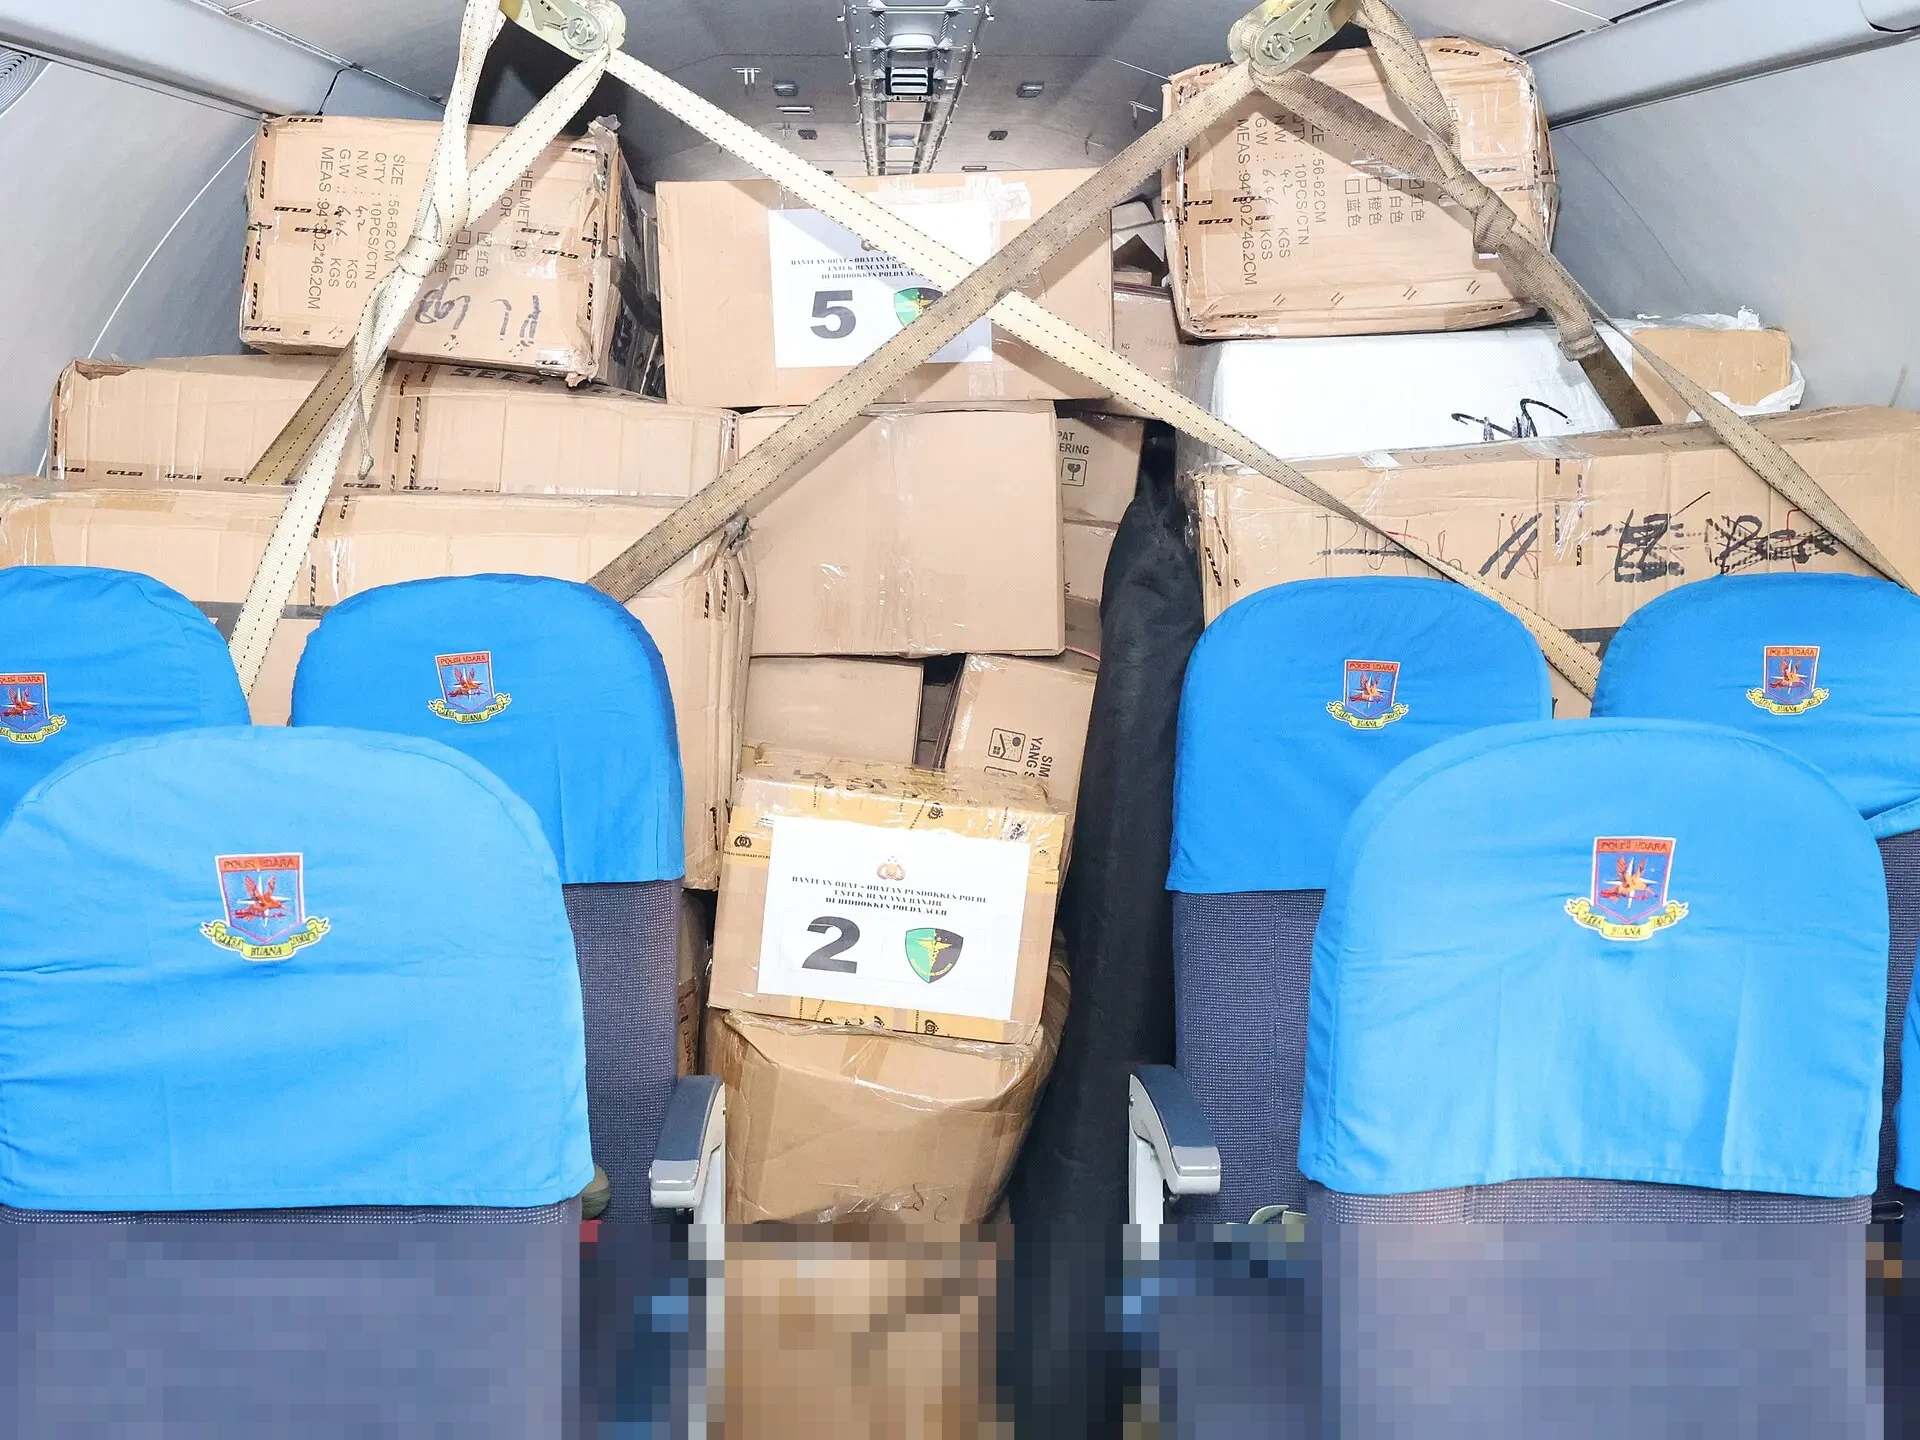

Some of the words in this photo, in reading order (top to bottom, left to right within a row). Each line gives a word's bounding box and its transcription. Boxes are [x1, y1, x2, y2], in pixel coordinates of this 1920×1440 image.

[1236, 118, 1251, 165] MEAS
[1255, 117, 1268, 146] G.W
[1312, 124, 1325, 145] ZE
[318, 146, 336, 193] MEAS
[339, 148, 352, 179] G.W
[356, 150, 370, 179] N.W
[373, 152, 388, 185] Q'TY
[391, 154, 406, 186] SIZE
[1346, 198, 1361, 228] 蓝色
[1368, 196, 1383, 226] 橙色
[1389, 196, 1403, 224] 白色
[1411, 193, 1425, 223] 红色
[364, 201, 382, 281] 10PCS/CTN
[1260, 228, 1273, 261] KGS
[1277, 227, 1292, 259] KGS
[328, 257, 342, 289] KGS
[345, 259, 358, 290] KGS
[434, 257, 449, 274] 色
[454, 249, 469, 277] 白色
[474, 249, 489, 278] 红色
[827, 257, 847, 265] OBAT
[828, 264, 853, 272] UNTUK
[855, 263, 890, 271] BENCANA
[810, 289, 857, 339] 5
[1057, 430, 1075, 442] PAT
[1059, 442, 1090, 455] ERING
[1026, 737, 1043, 768] YANG
[1038, 755, 1053, 778] SIM
[834, 889, 863, 898] UNTUK
[866, 893, 906, 902] BENCANA
[909, 897, 942, 907] BANJIR
[835, 881, 858, 889] OBAT
[867, 884, 902, 894] OBATAN
[905, 888, 957, 900] PUSDOKKES
[959, 894, 986, 903] POLRI
[838, 898, 890, 910] BIDDOKKES
[892, 903, 921, 913] POLDA
[926, 908, 947, 916] ACEH
[250, 946, 283, 956] BUANA
[802, 915, 861, 974] 2
